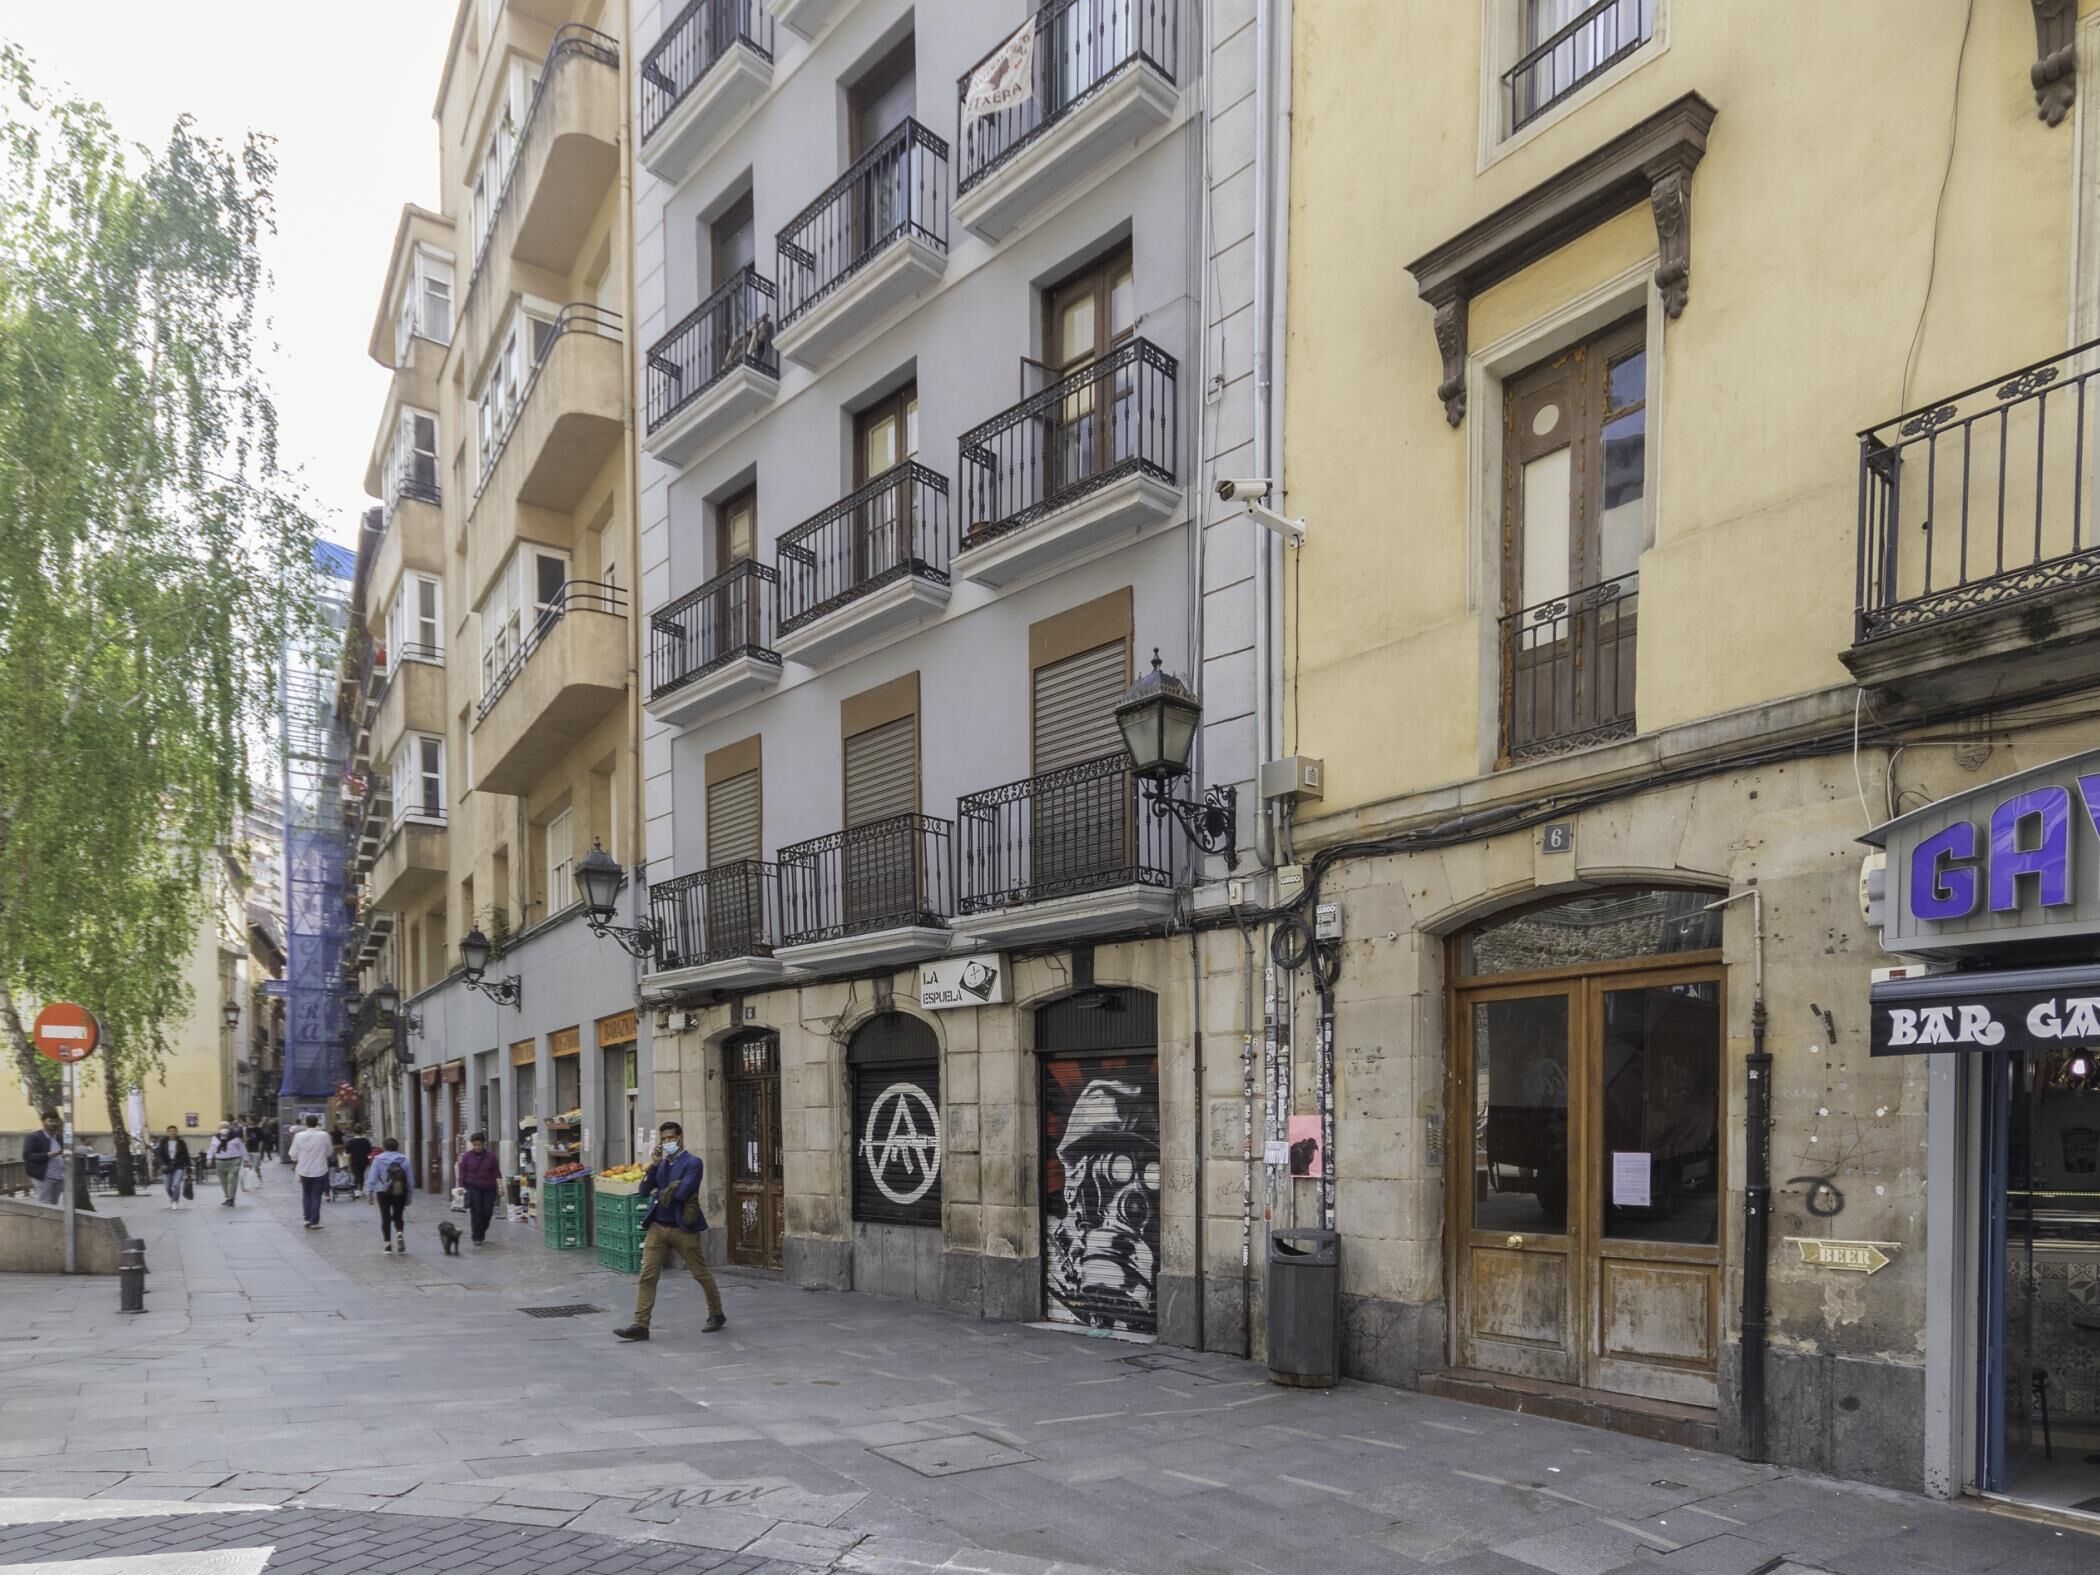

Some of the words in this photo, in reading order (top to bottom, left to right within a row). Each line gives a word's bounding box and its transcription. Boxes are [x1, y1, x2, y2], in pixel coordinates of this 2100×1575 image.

[1551, 828, 1562, 848] 6
[1910, 772, 2100, 920] GA
[923, 971, 938, 985] LA
[923, 990, 963, 1005] ESPUELA
[1887, 1004, 2006, 1046] BAR
[1820, 1247, 1871, 1265] BEER
